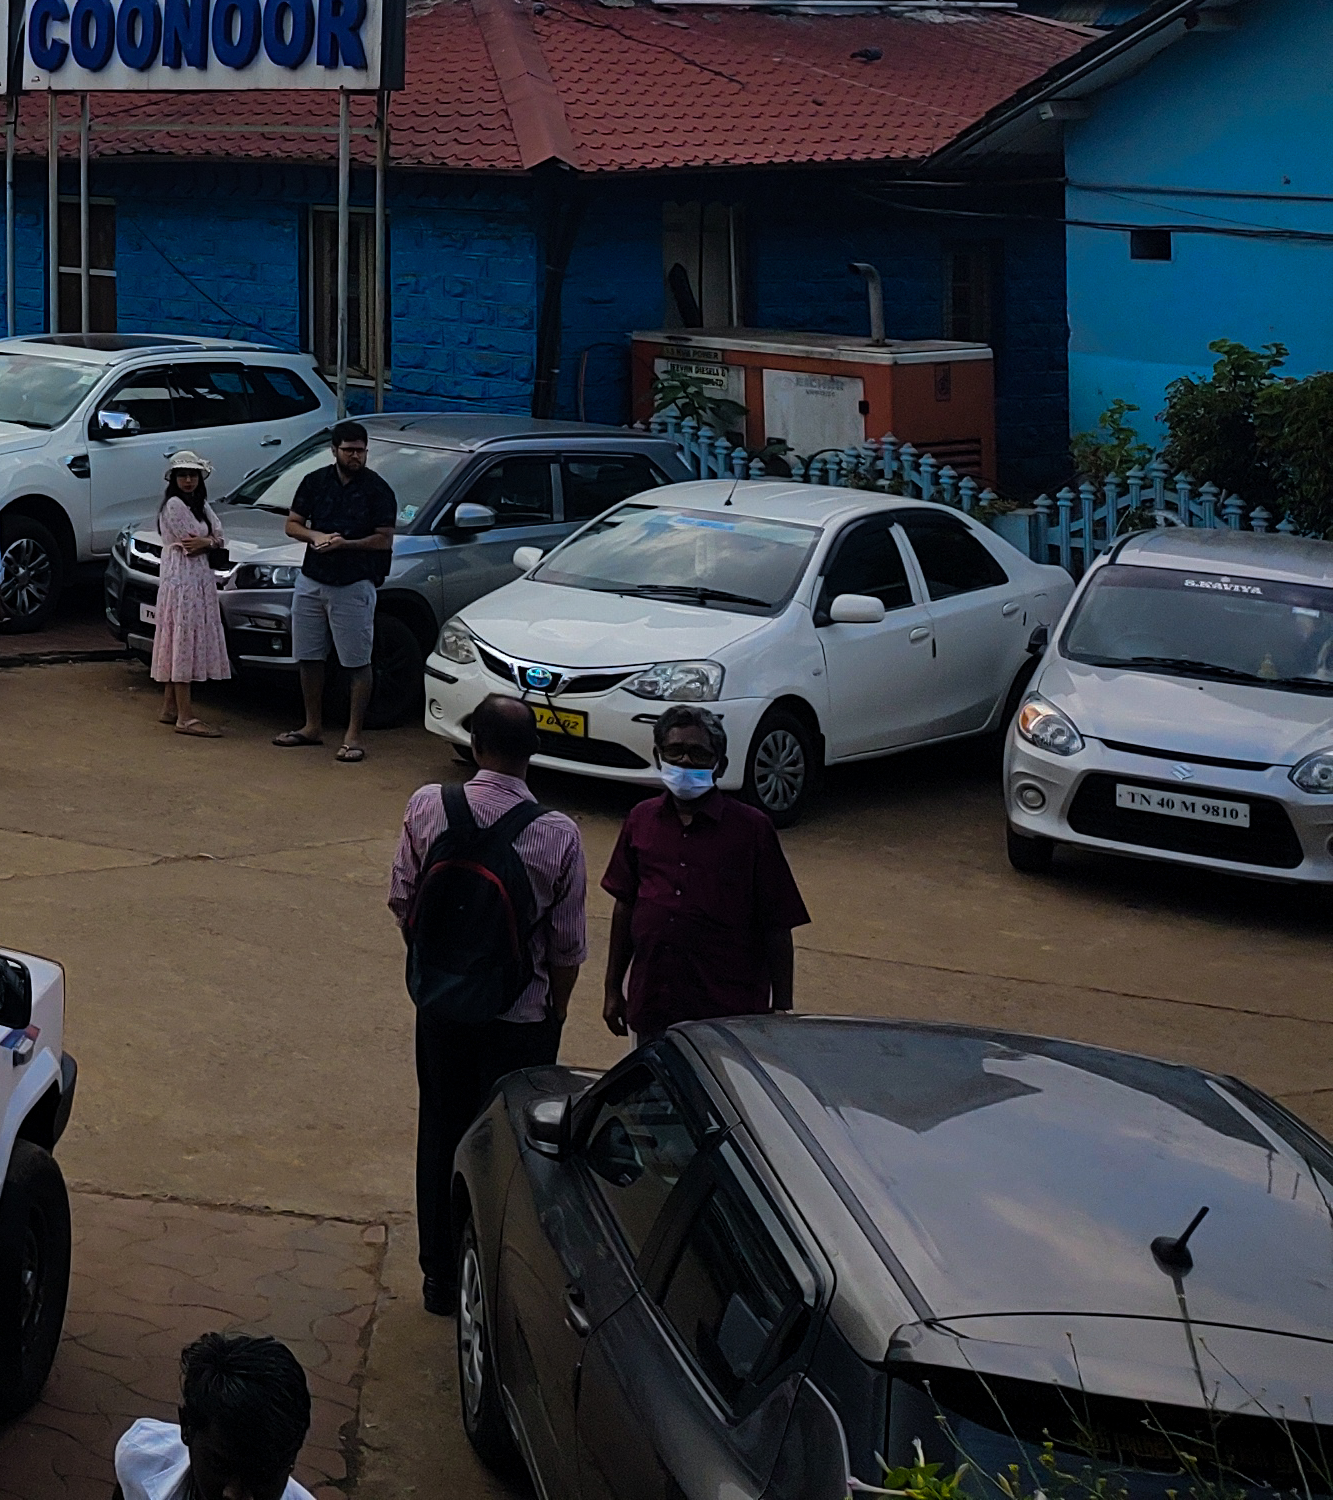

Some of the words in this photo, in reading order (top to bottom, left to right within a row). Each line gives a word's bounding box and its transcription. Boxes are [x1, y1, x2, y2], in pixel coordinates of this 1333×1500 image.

[1184, 579, 1263, 595] S.KAVIYA
[1127, 791, 1151, 806] TN
[1157, 797, 1175, 810] 40
[1180, 800, 1196, 813] M
[1201, 803, 1239, 820] 9810
